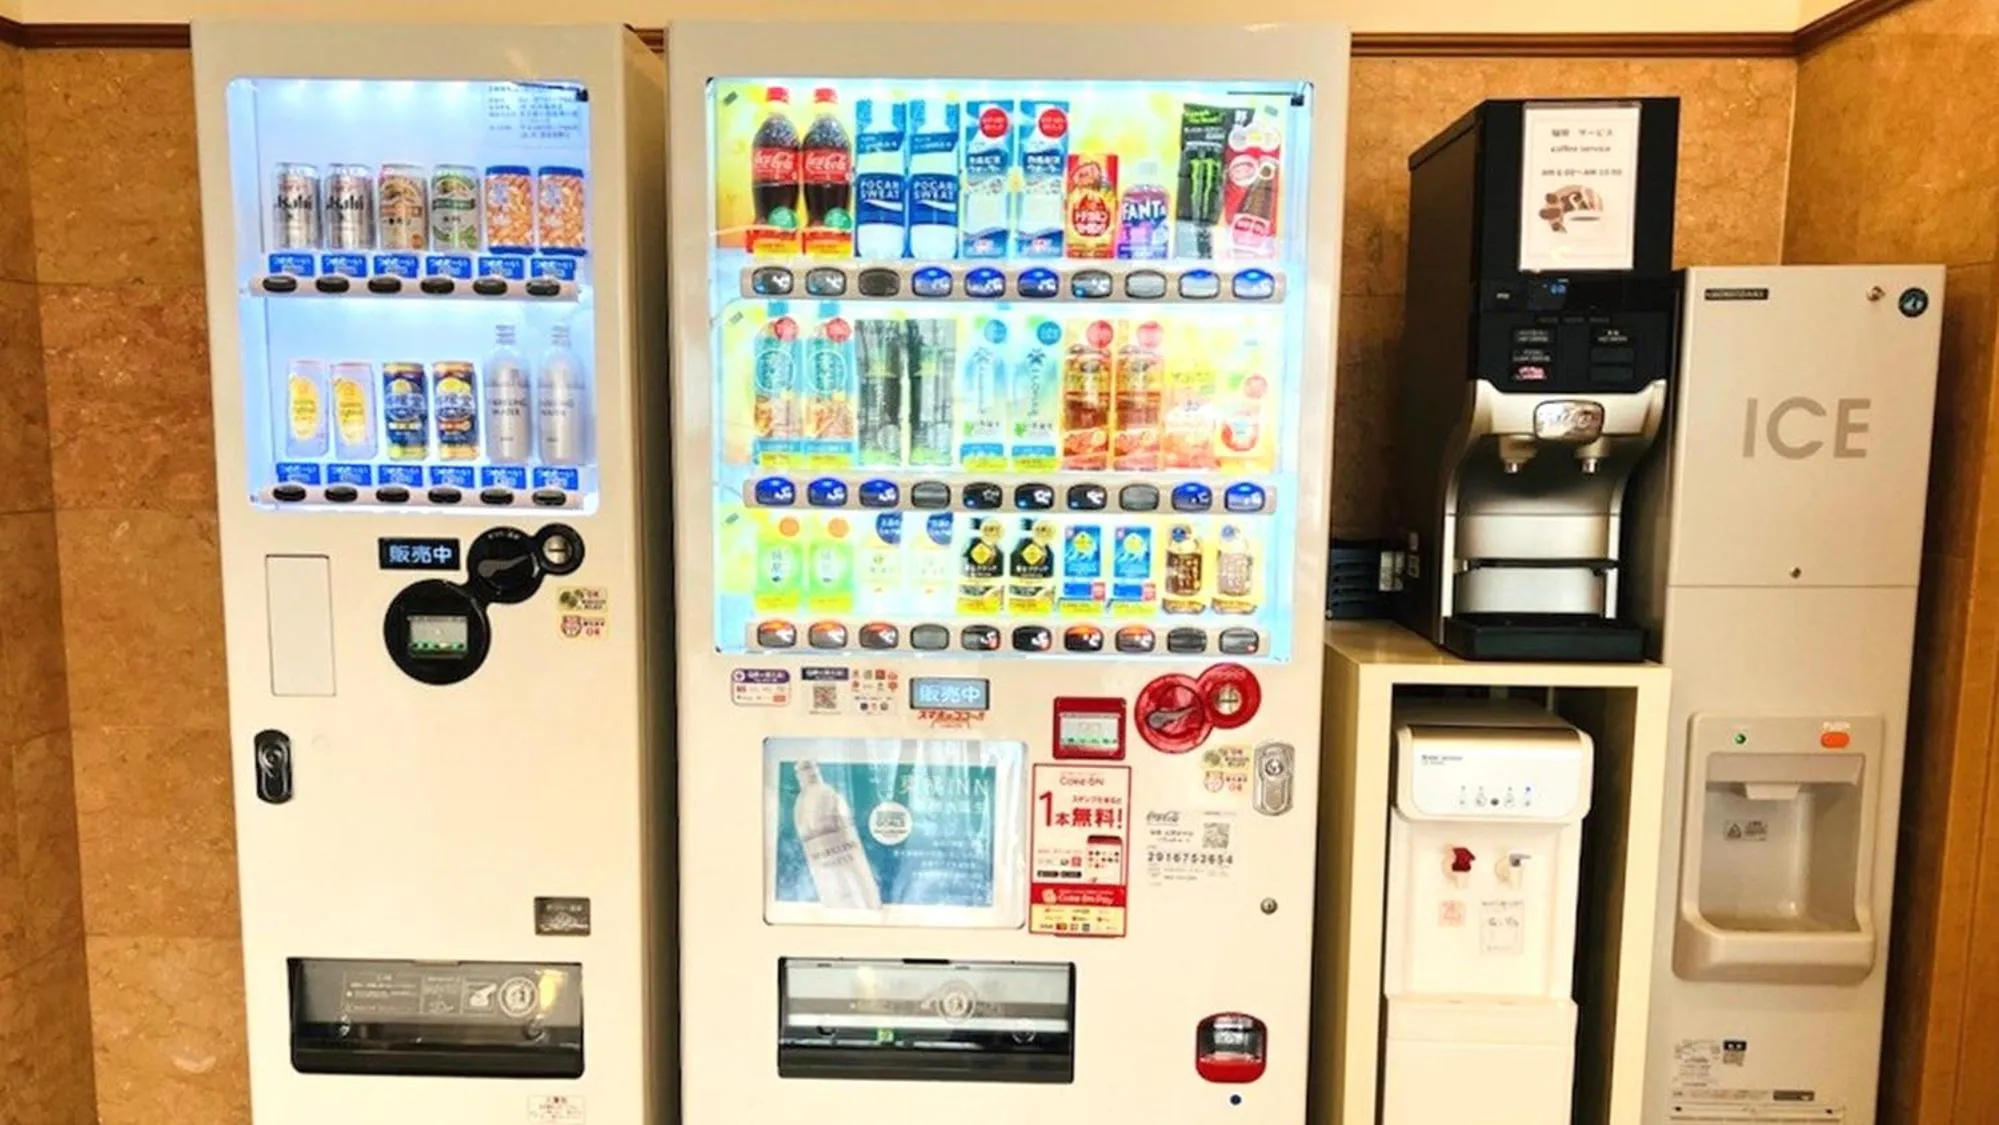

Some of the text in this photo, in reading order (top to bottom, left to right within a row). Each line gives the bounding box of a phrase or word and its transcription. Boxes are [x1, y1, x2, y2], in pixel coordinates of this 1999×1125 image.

[1742, 396, 1872, 460] ICE
[389, 544, 452, 564] 販売中
[920, 684, 980, 702] 販売中
